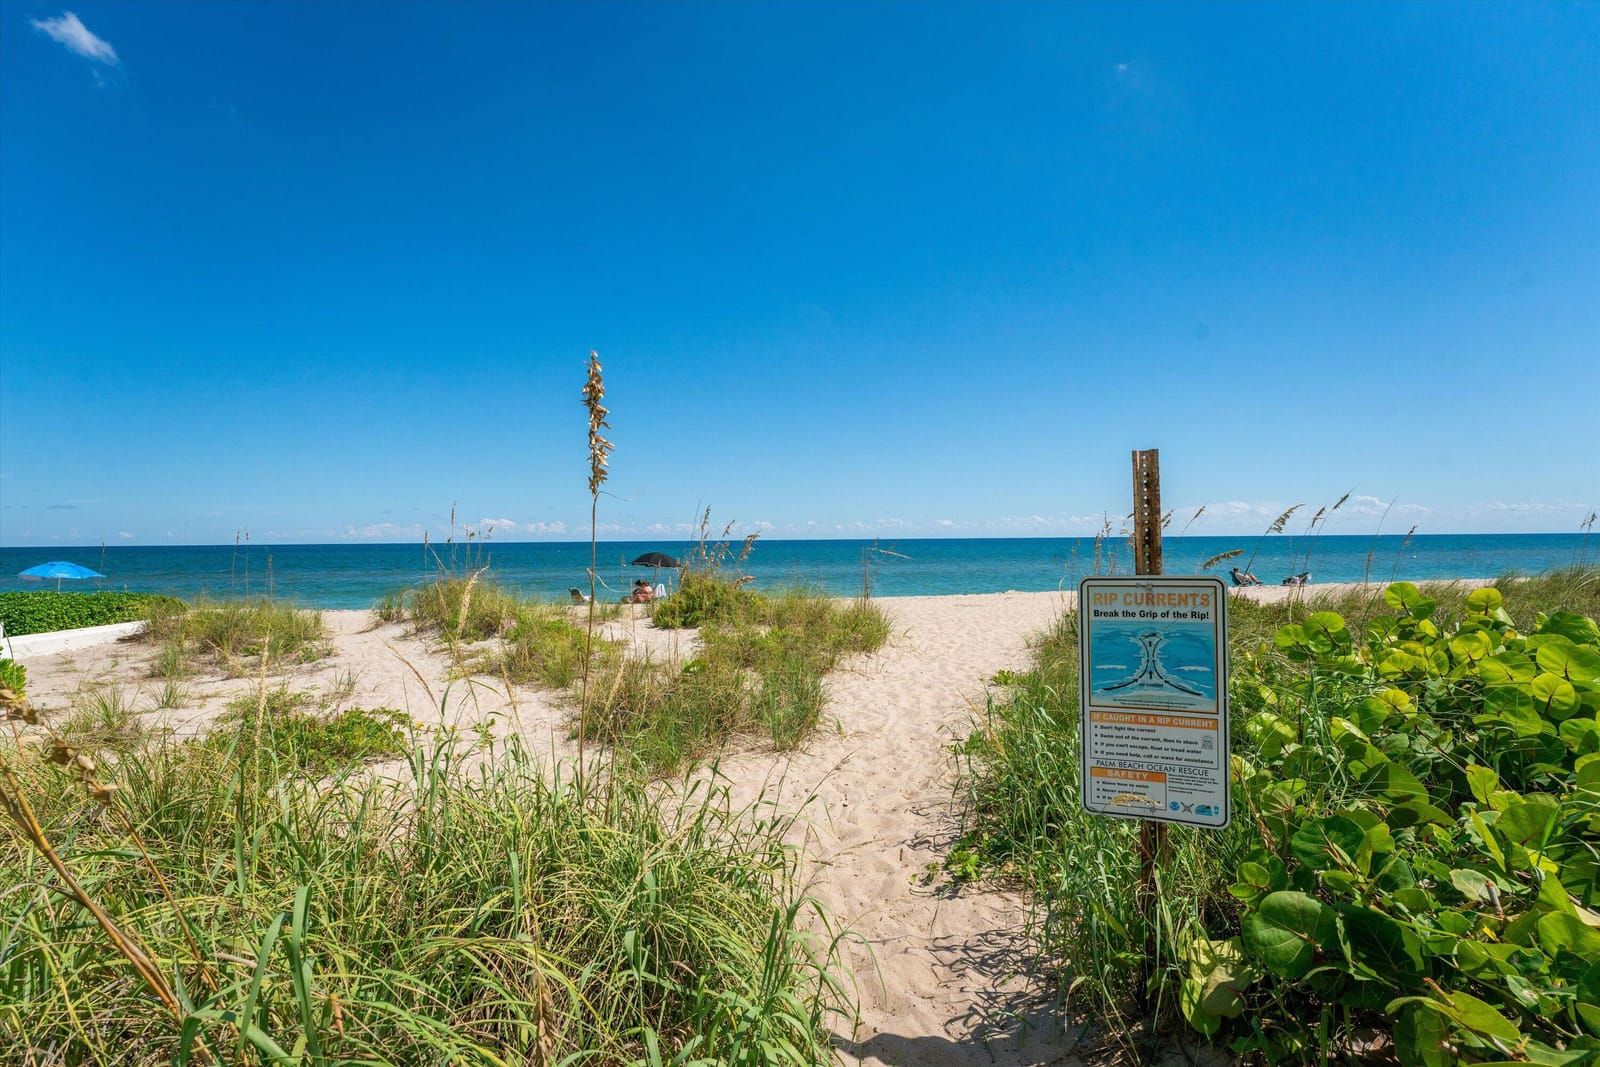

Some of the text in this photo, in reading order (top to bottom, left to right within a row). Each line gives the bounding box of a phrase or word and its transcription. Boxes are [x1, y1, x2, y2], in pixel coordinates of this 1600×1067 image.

[1093, 592, 1210, 607] RIP CURRENTS
[1093, 609, 1209, 620] Break the Grip of the Rip!
[1103, 713, 1136, 723] CAUGHT
[1149, 716, 1155, 724] A
[1157, 716, 1171, 725] RIP
[1173, 718, 1214, 728] CURRENT
[1096, 759, 1209, 777] PALM BEACH OCEAN RESCUE
[1107, 769, 1149, 780] SAFETY
